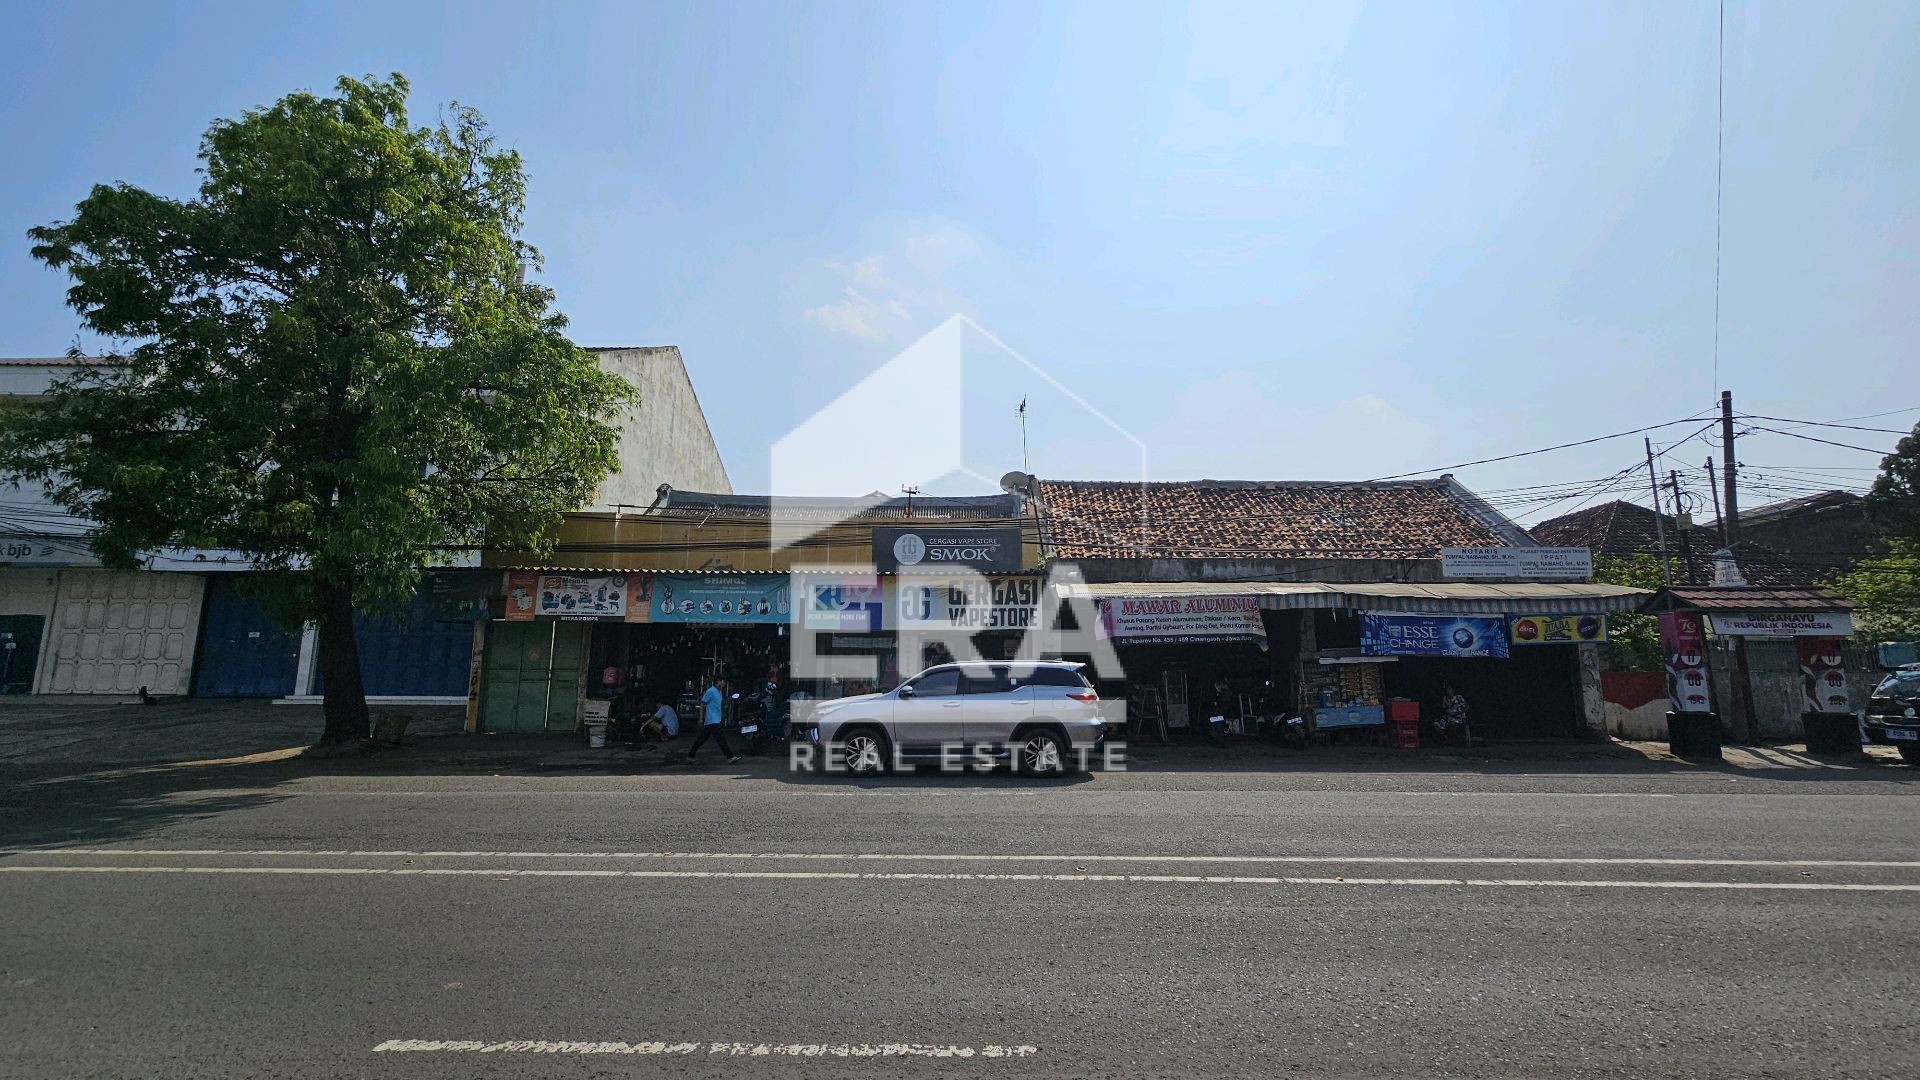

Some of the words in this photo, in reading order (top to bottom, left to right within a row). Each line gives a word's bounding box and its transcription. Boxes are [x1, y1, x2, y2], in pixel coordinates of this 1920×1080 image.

[8, 544, 32, 559] bjb
[930, 547, 993, 562] SMOK
[948, 579, 1038, 606] GERGASI
[1121, 599, 1182, 616] MAWAR
[1734, 621, 1779, 629] REPUBLIK
[1781, 621, 1833, 629] INDONESIA
[1748, 614, 1815, 623] DIRGAHAYU
[1403, 625, 1439, 639] ESSE
[1389, 638, 1440, 649] CHANGE
